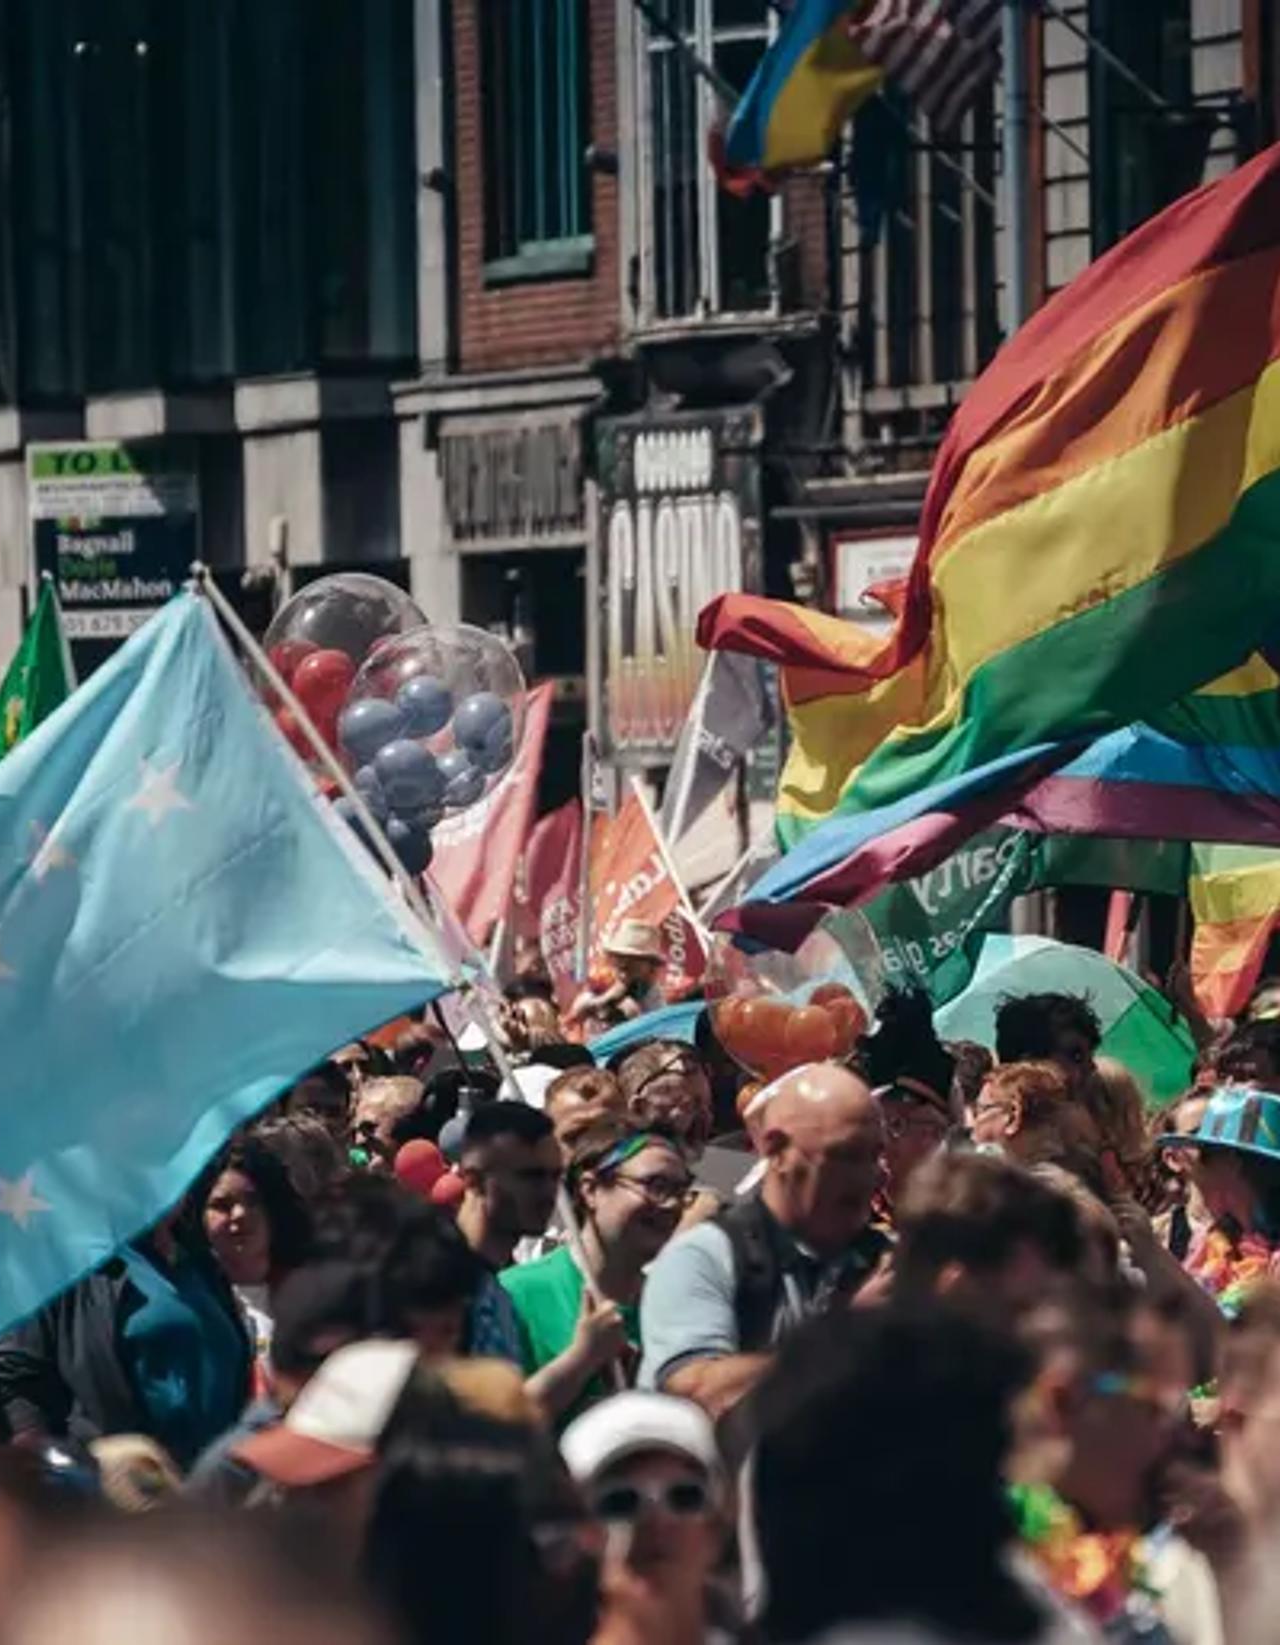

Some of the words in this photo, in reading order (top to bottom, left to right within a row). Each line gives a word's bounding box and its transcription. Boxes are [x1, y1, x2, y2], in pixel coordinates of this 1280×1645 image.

[53, 452, 98, 474] TO
[58, 530, 136, 559] Bagnall
[60, 577, 172, 600] MacMahon
